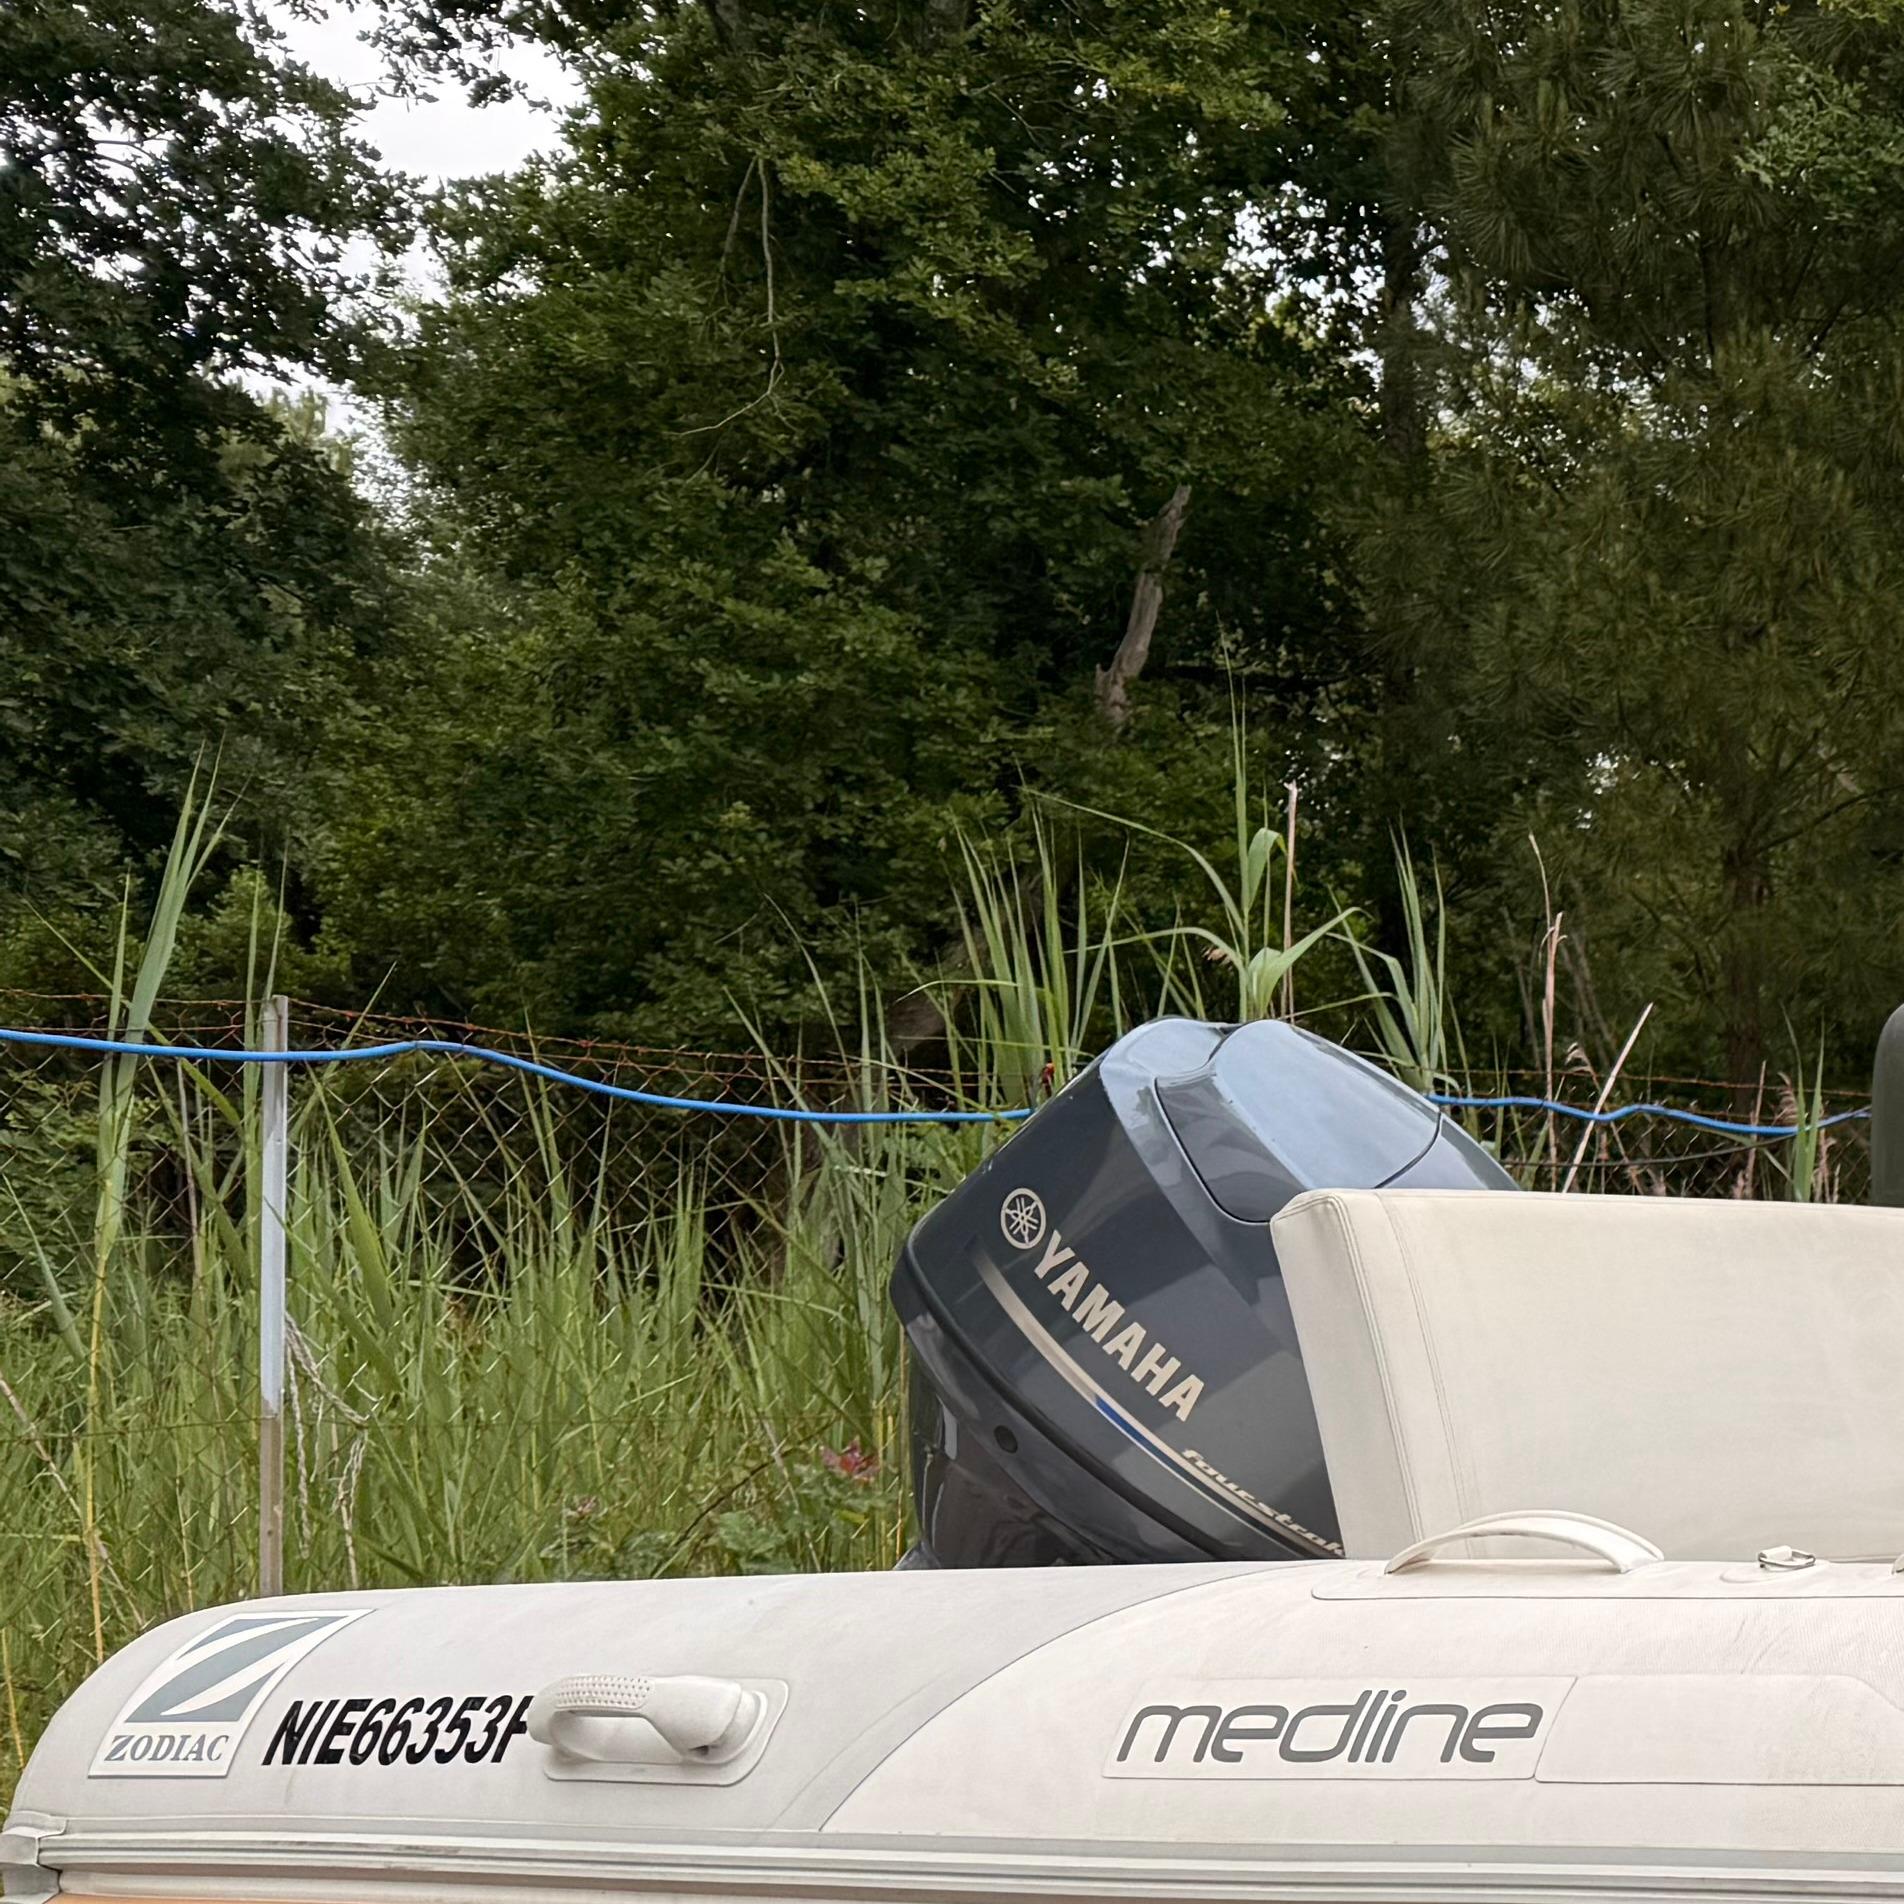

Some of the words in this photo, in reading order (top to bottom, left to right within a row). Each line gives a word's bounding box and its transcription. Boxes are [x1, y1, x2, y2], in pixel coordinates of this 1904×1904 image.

[1034, 1229, 1204, 1422] YAMAHA
[1182, 1449, 1345, 1556] fourstrok
[103, 1734, 230, 1763] ZODIAC
[1116, 1689, 1543, 1763] medline
